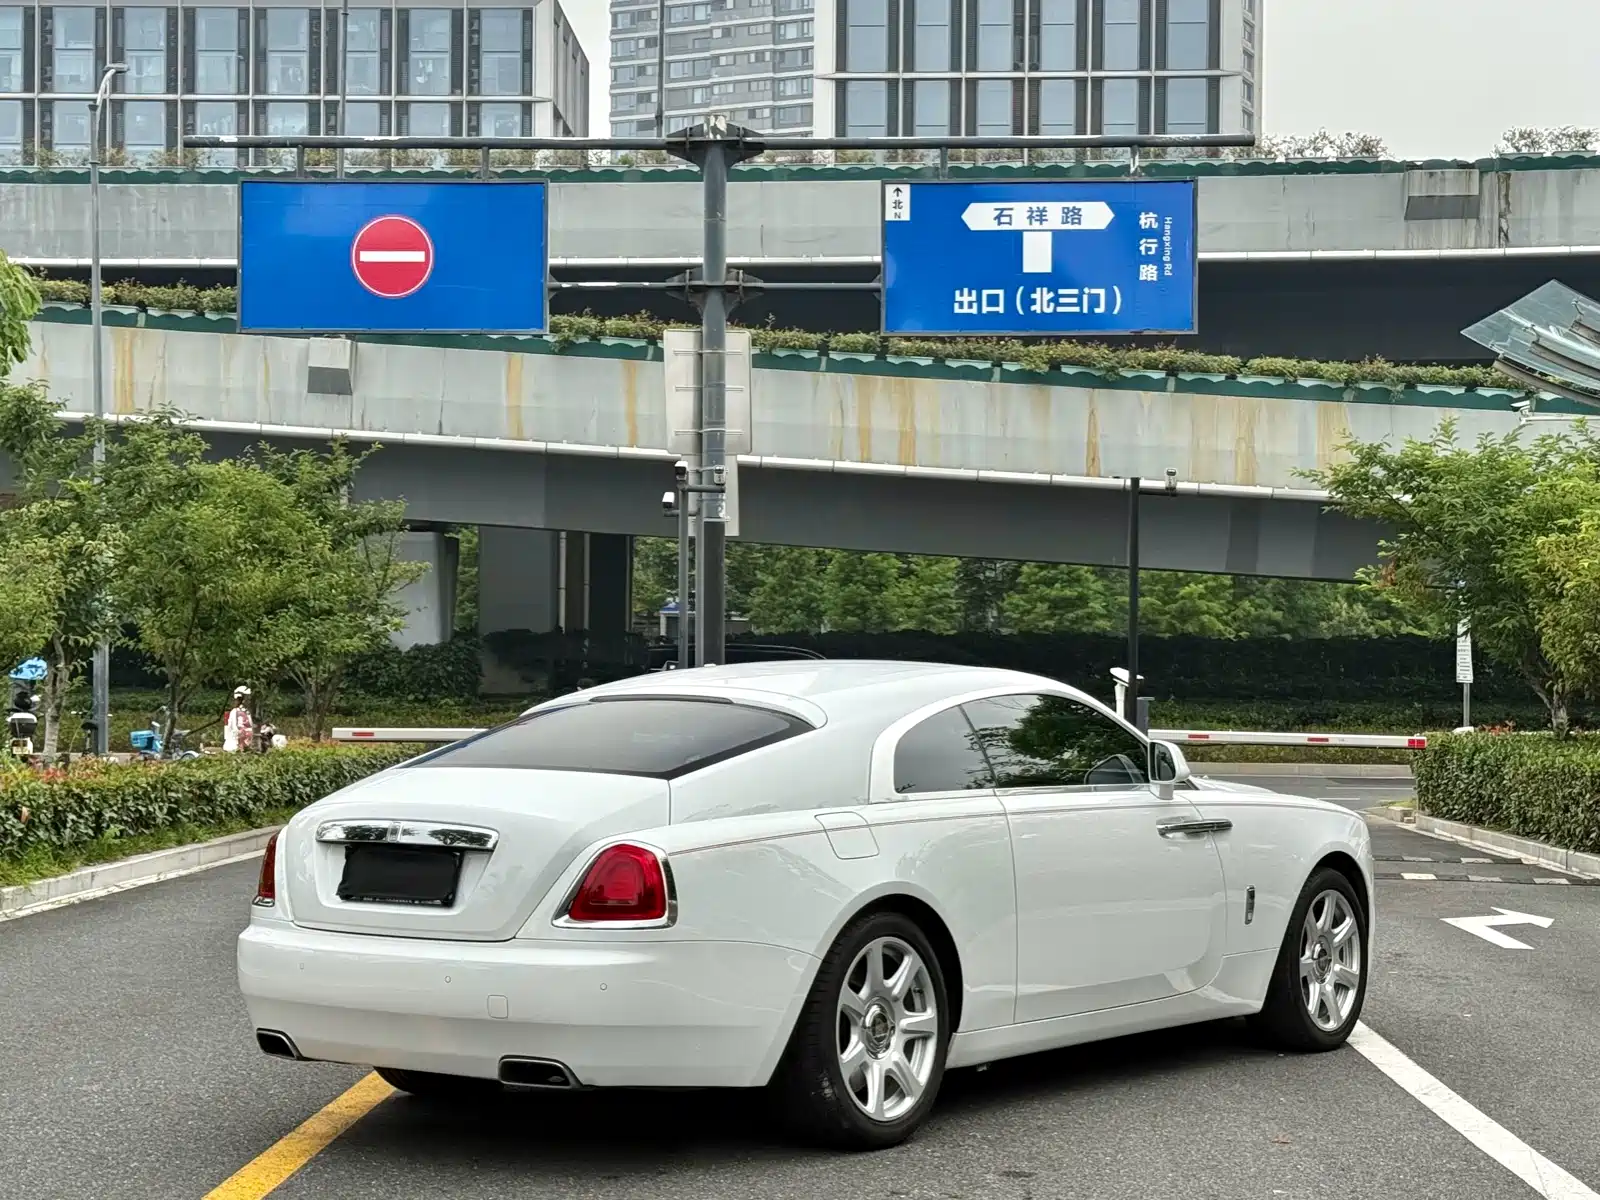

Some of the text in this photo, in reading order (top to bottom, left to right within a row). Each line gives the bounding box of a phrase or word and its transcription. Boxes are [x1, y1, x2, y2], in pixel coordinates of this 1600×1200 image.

[892, 199, 904, 210] 北
[893, 211, 902, 220] N
[993, 206, 1083, 227] 石祥路
[1139, 211, 1159, 281] 杭行路
[1162, 216, 1173, 276] Hangxing Rd
